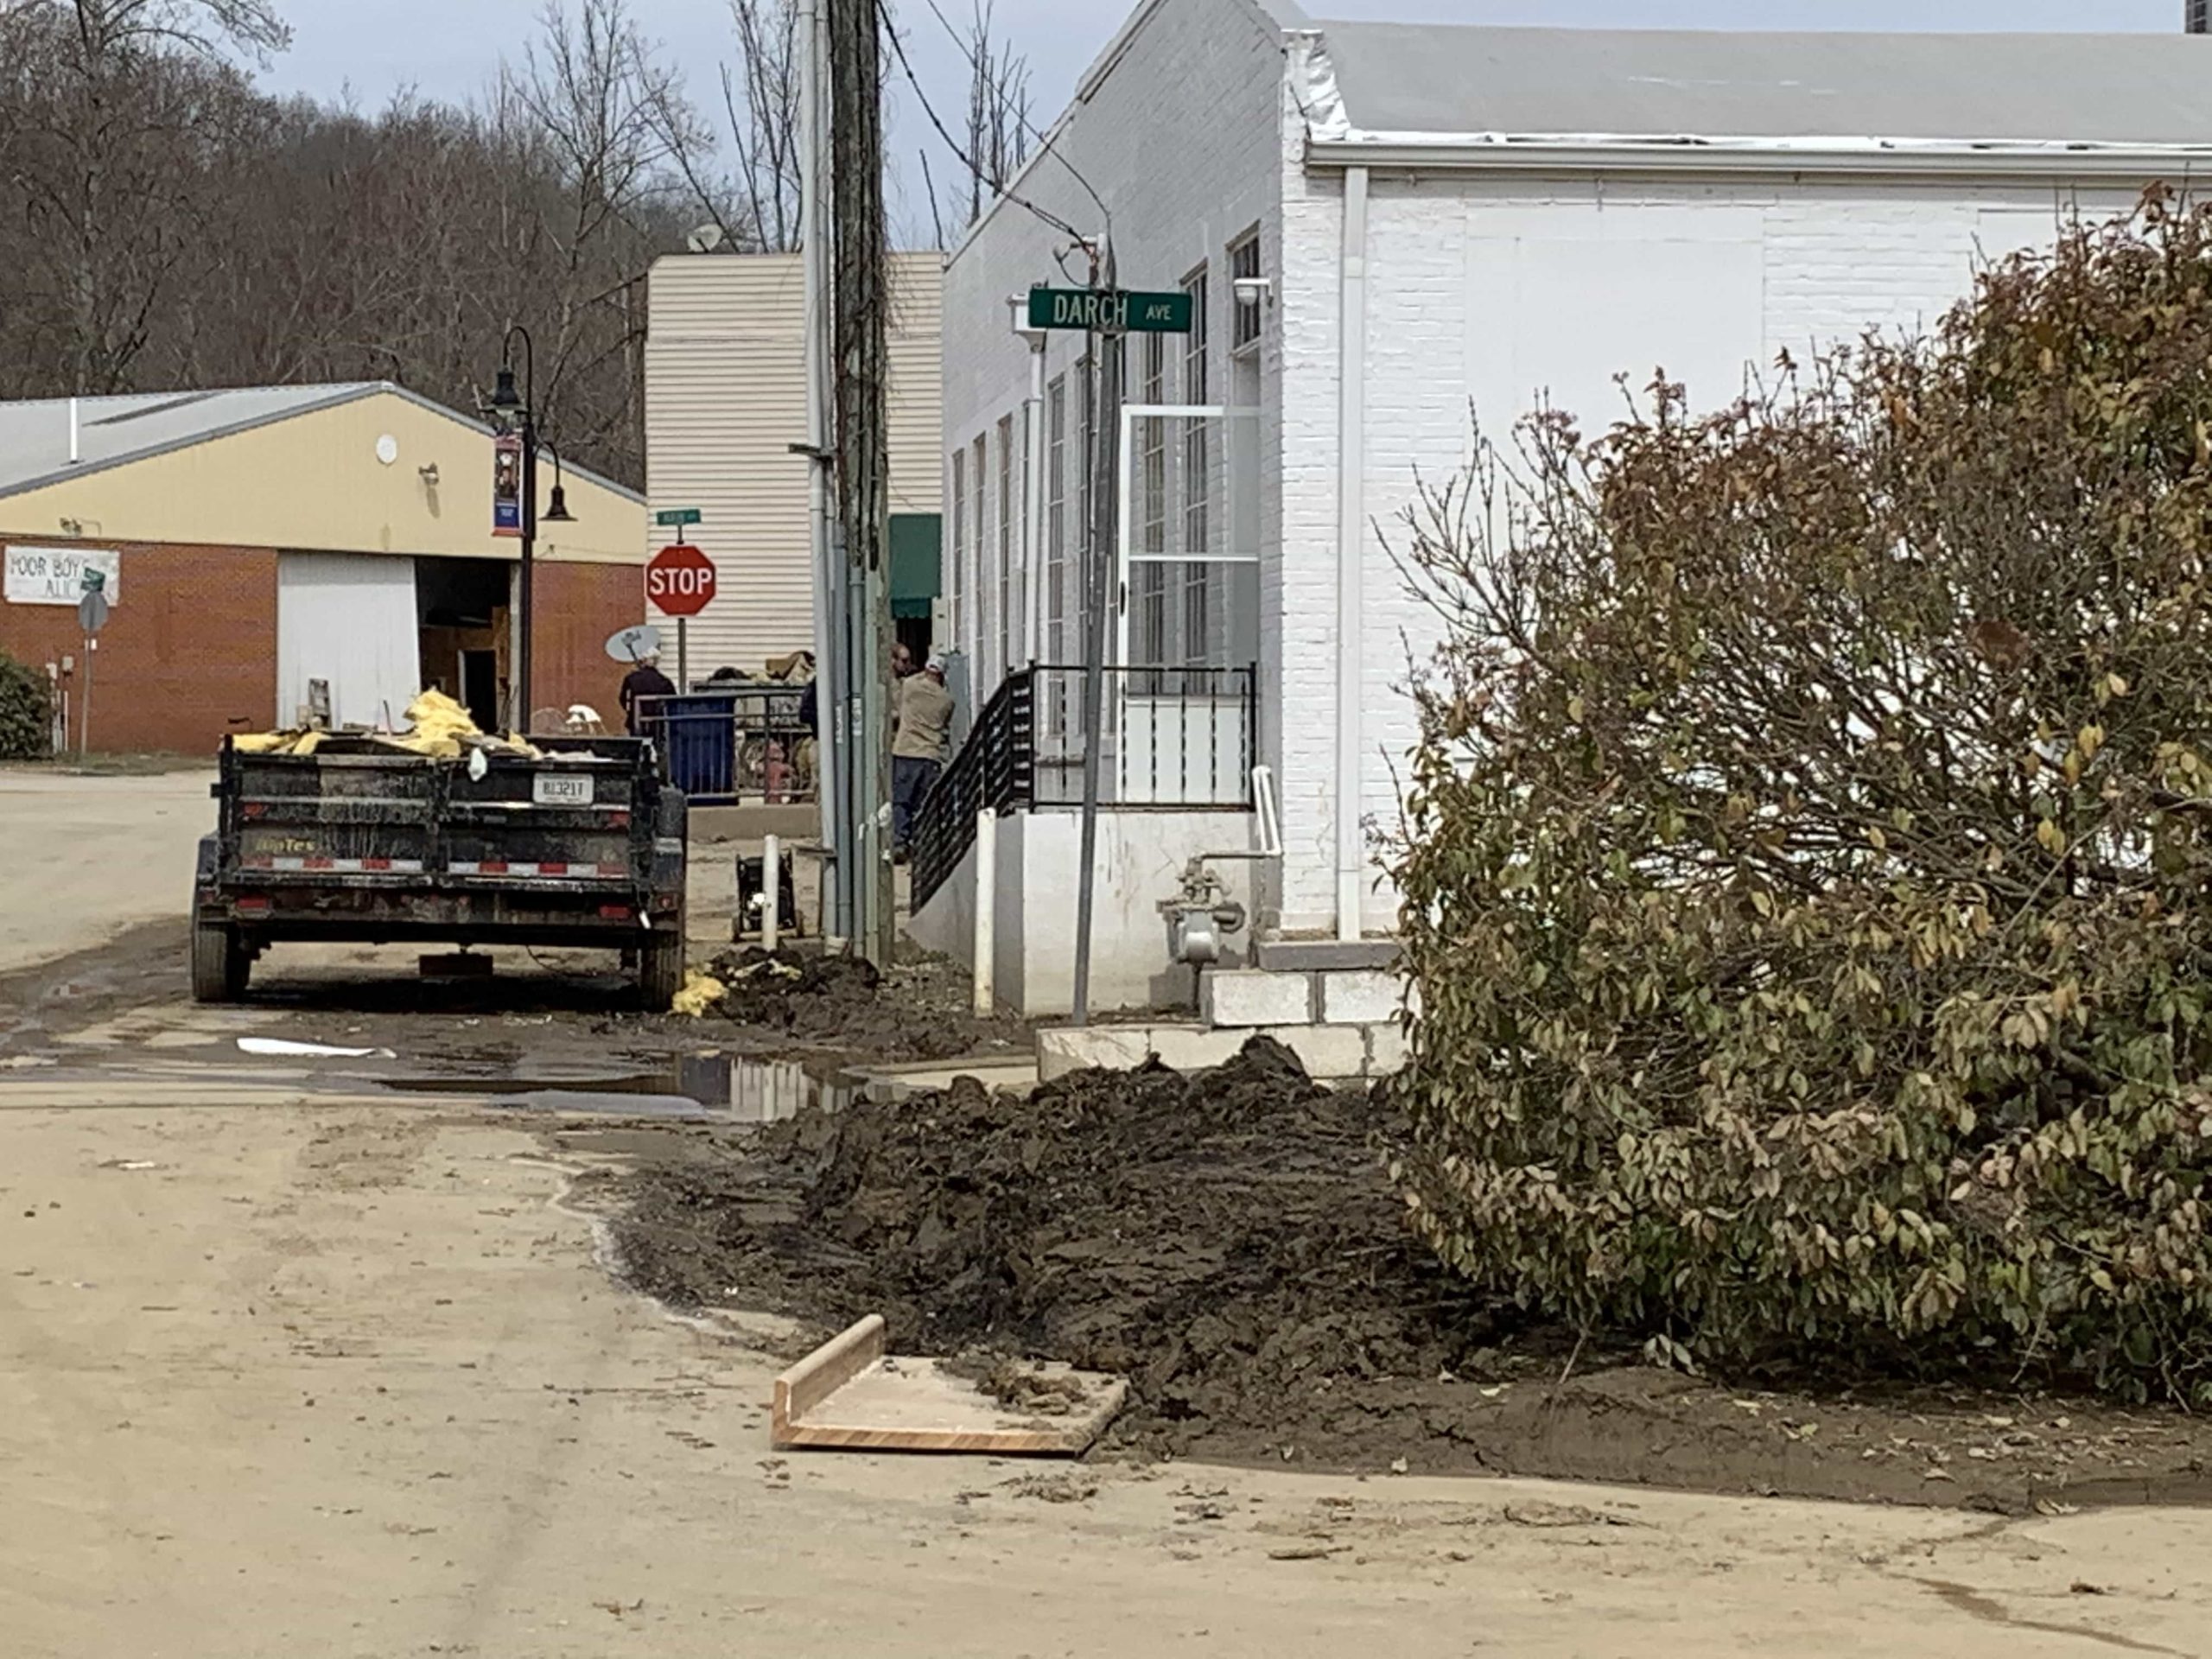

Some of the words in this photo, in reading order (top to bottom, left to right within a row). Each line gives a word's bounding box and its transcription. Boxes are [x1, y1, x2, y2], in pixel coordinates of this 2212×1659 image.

[1053, 294, 1128, 326] DARCH
[1146, 304, 1173, 321] AVE
[649, 567, 712, 595] STOP
